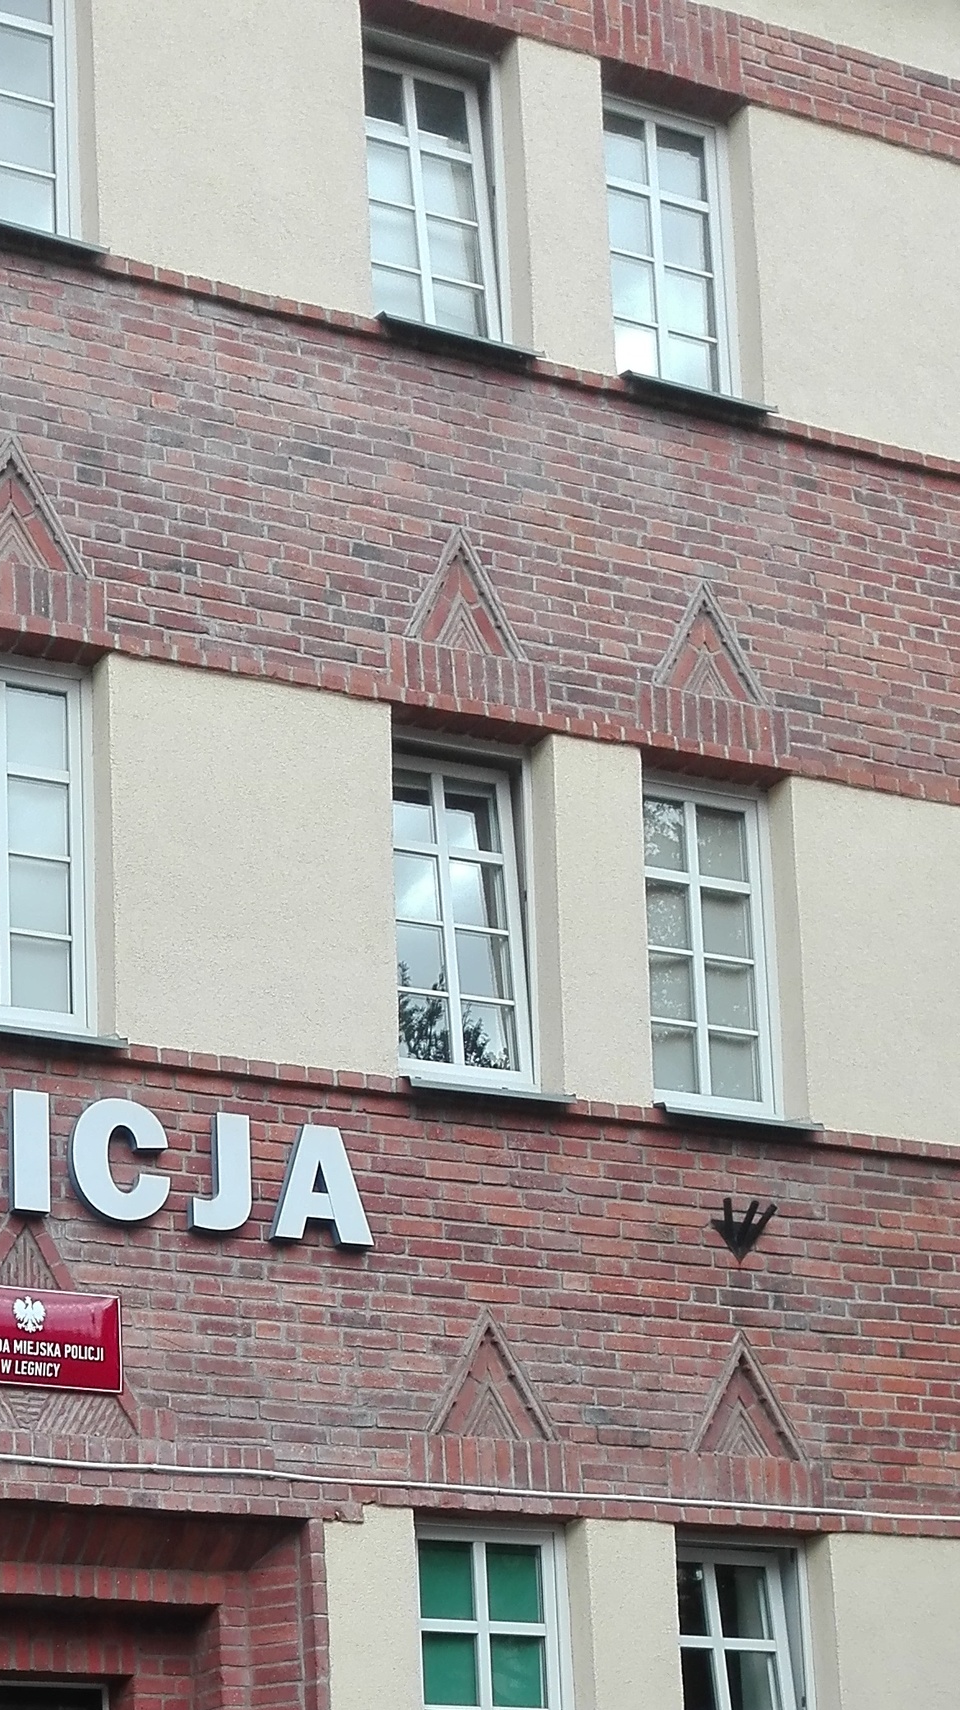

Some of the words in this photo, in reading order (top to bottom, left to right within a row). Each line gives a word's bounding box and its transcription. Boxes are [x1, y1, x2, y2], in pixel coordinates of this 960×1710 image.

[13, 1340, 61, 1357] MIEJSKA
[64, 1344, 104, 1361] POLICJI
[0, 1359, 12, 1374] W
[15, 1361, 60, 1377] LEGNICY
